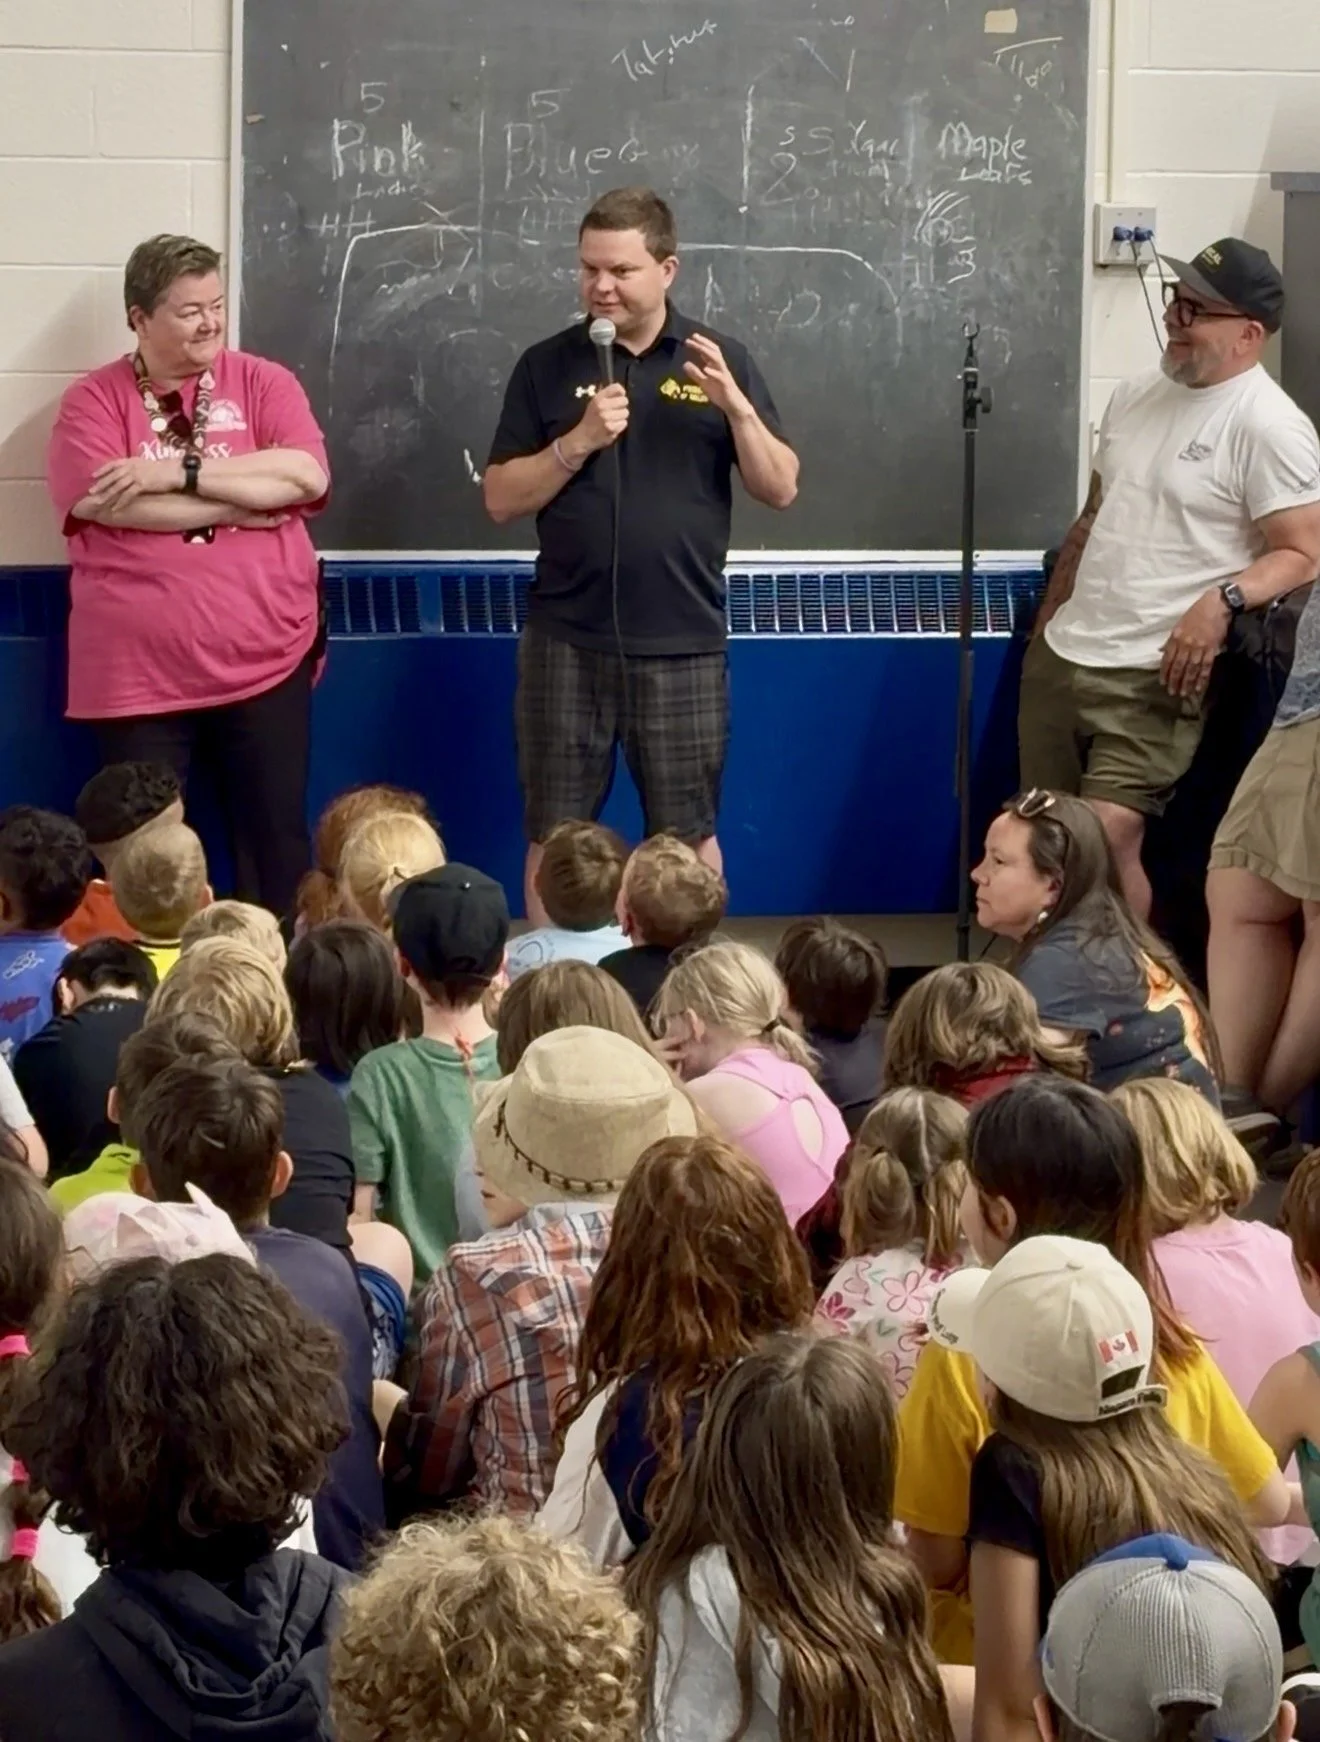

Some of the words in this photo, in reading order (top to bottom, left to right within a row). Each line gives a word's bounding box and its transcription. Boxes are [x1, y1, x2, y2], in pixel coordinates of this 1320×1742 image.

[360, 81, 388, 113] 5
[531, 88, 571, 118] 5
[331, 118, 425, 181] Pink
[938, 121, 1028, 173] Maple
